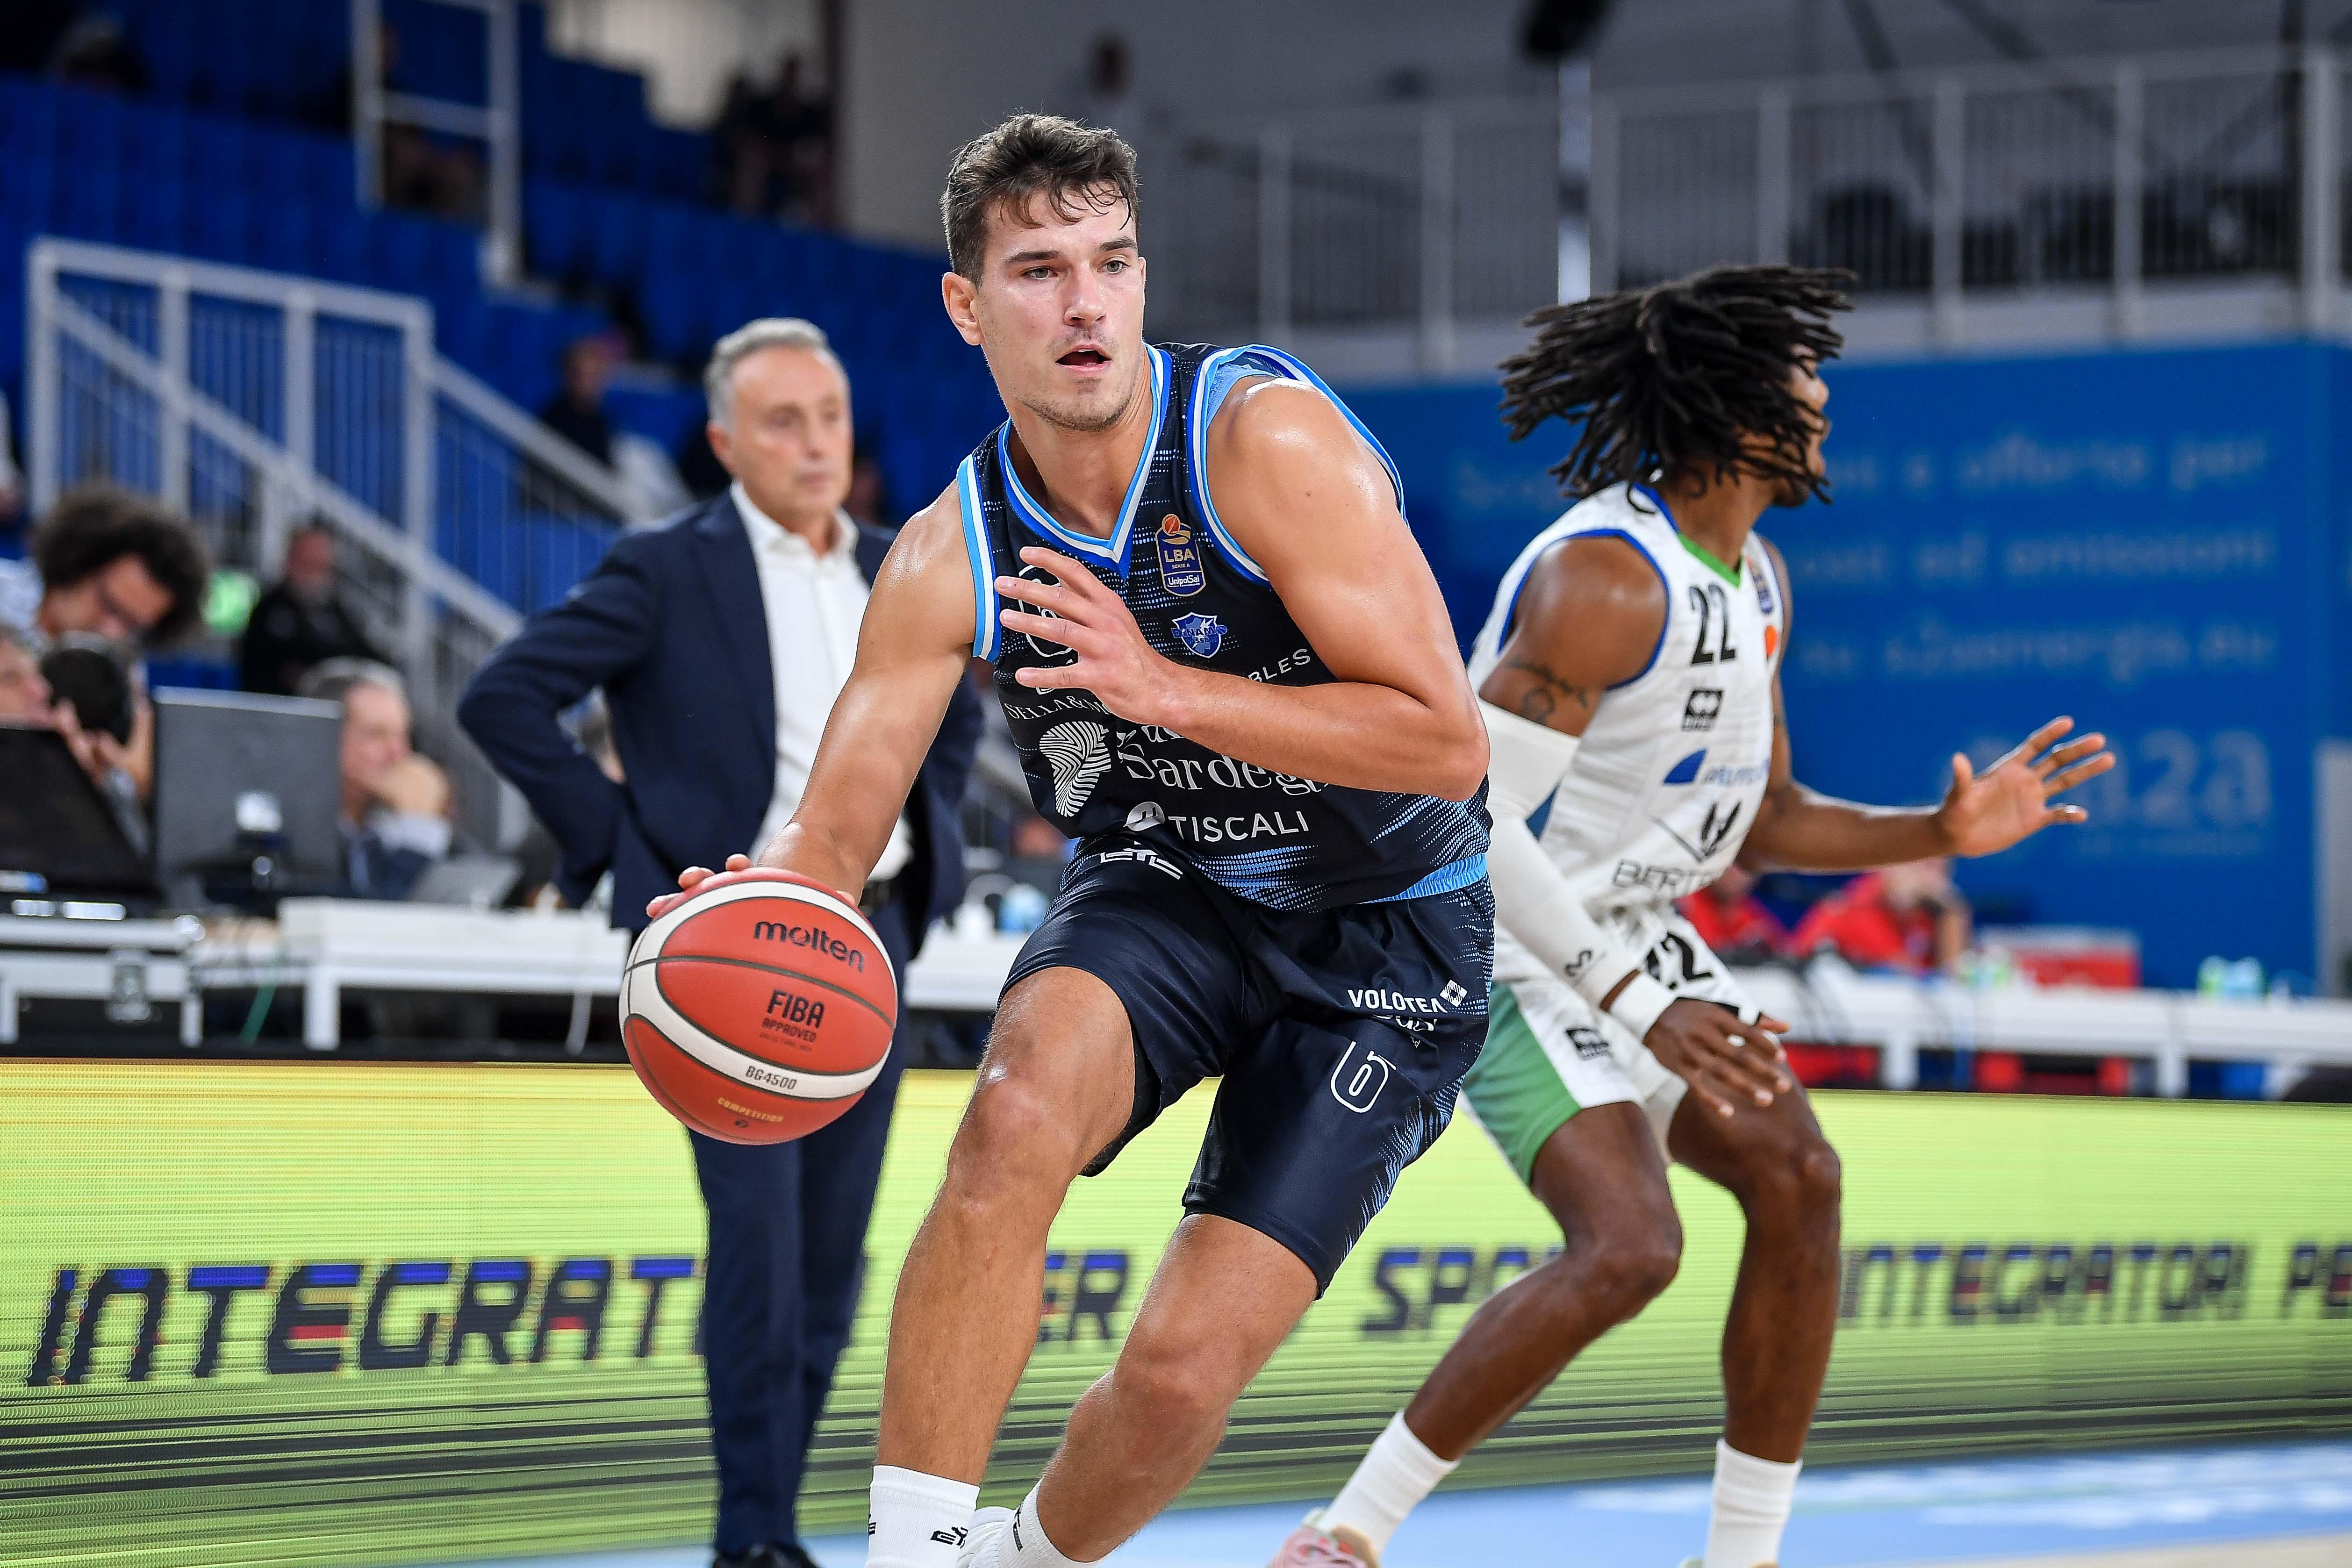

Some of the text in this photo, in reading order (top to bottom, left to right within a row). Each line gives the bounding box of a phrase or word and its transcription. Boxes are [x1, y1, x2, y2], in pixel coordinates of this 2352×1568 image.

[1164, 548, 1195, 563] LBA
[1168, 575, 1200, 586] UnipolSai
[1690, 584, 1735, 664] 22
[1248, 648, 1311, 682] BLES
[1118, 743, 1329, 795] Sardeg
[1168, 811, 1309, 842] TISCALI
[754, 921, 864, 972] molten
[767, 989, 825, 1029] FIBA
[1347, 988, 1448, 1013] VOLOTEA
[762, 1018, 817, 1043] APPROVED
[745, 1066, 797, 1089] BG4500
[27, 1256, 707, 1387] INTEGRAT
